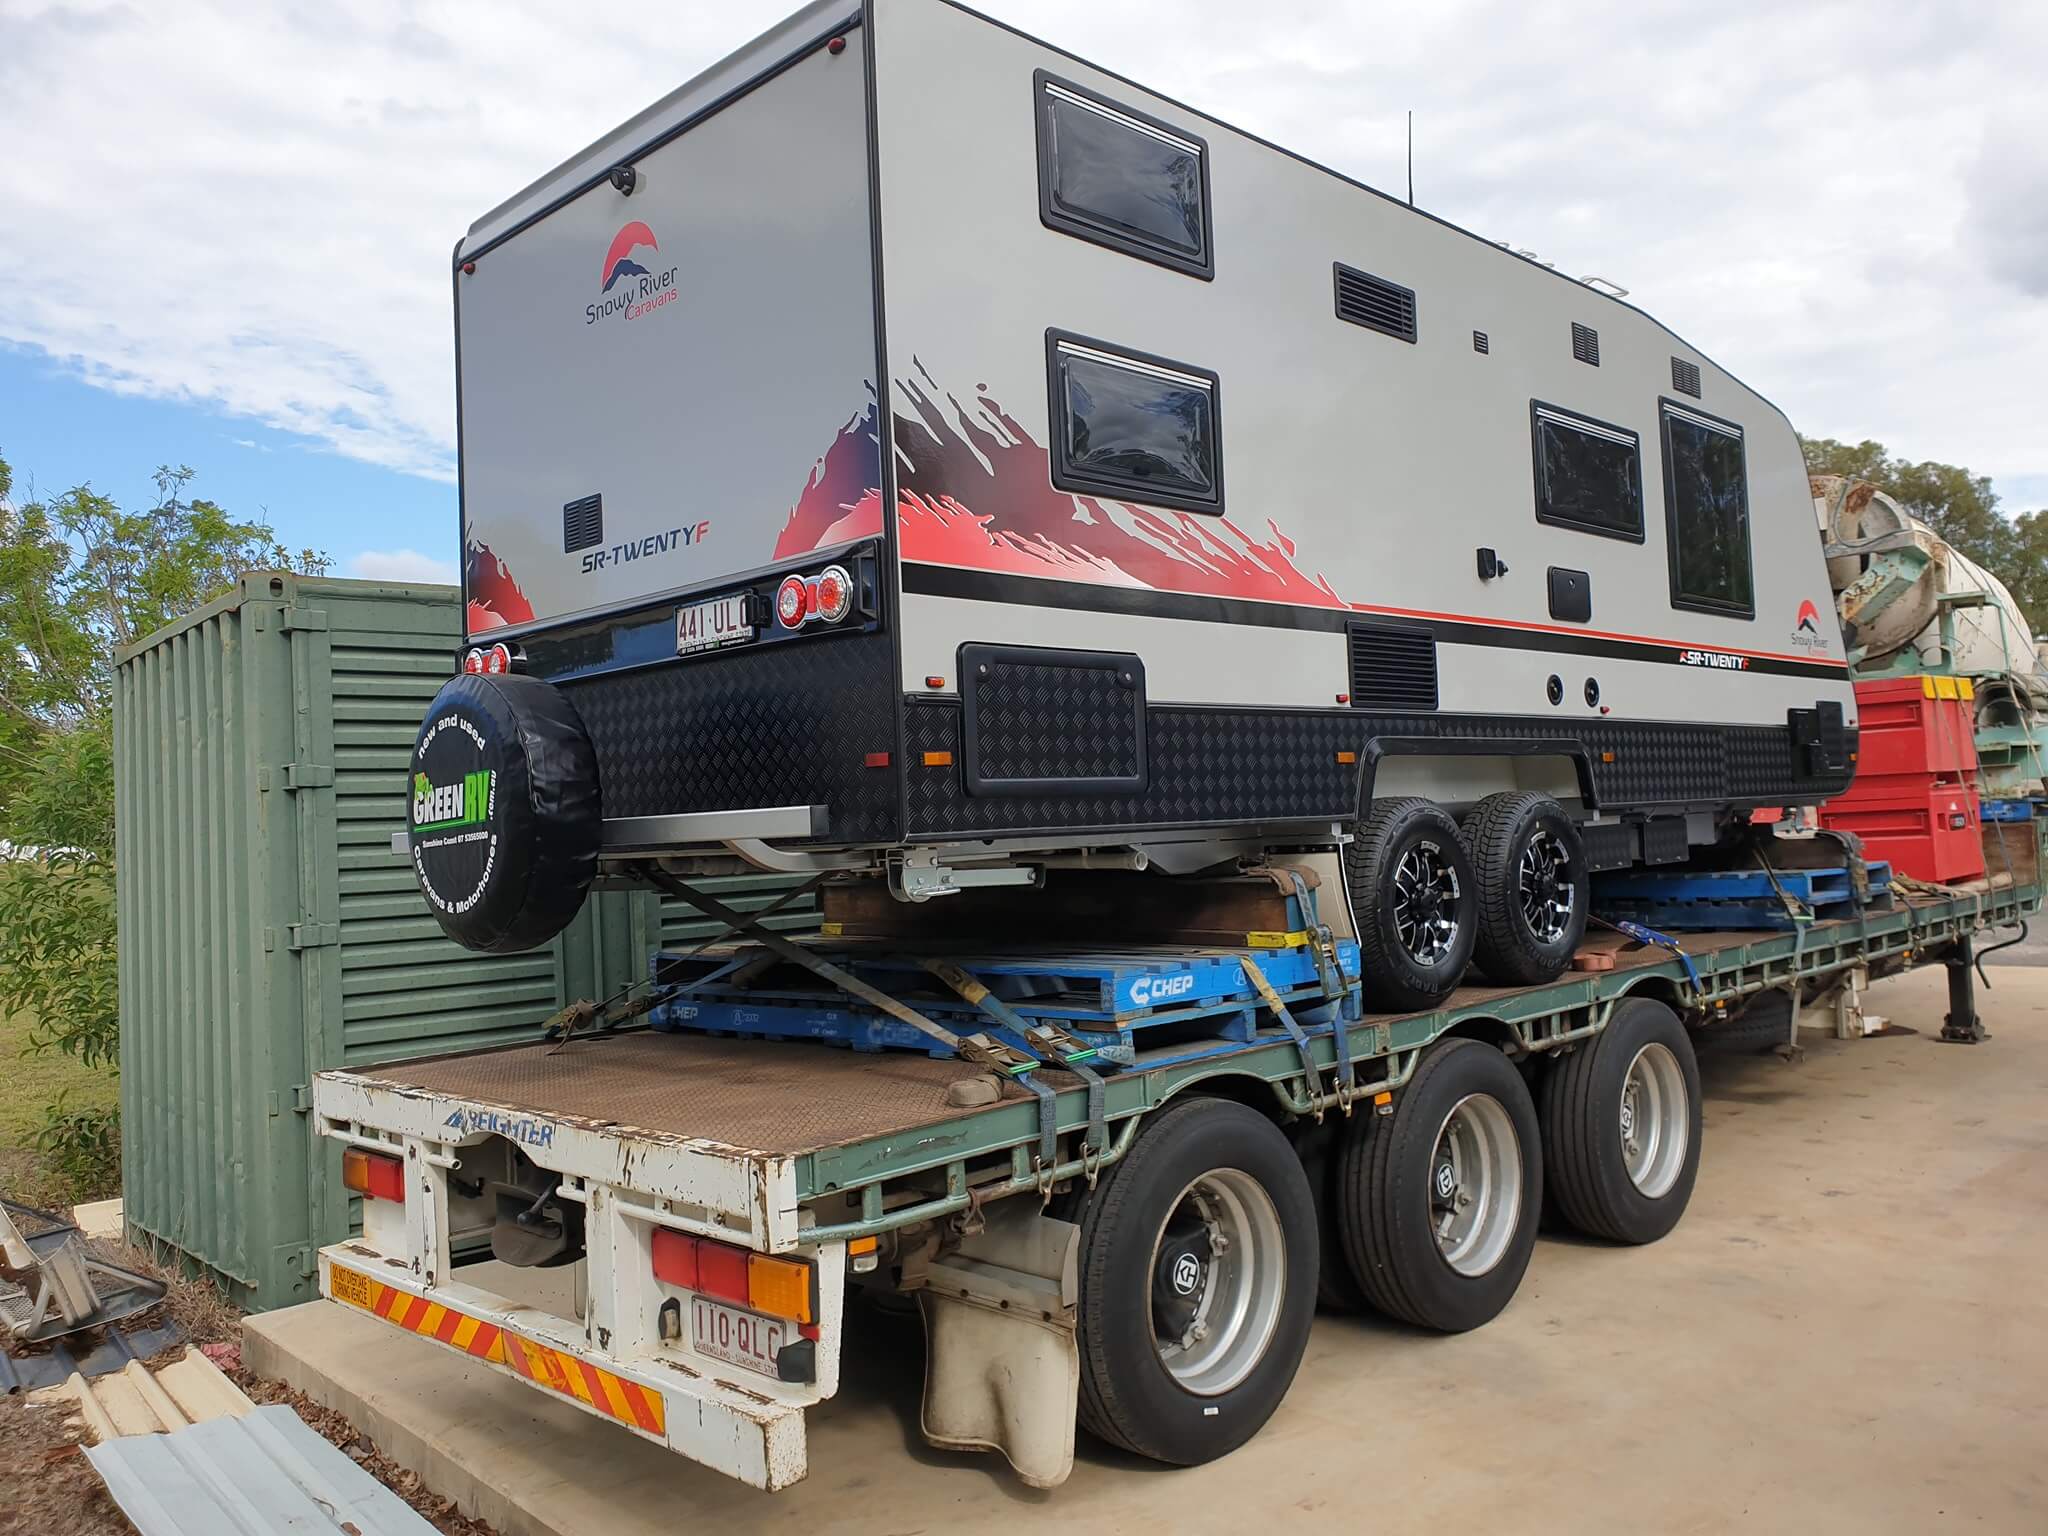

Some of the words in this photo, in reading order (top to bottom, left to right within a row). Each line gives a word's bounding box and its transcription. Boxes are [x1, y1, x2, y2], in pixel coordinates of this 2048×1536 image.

[586, 289, 634, 325] Snowy
[640, 266, 678, 299] River
[626, 288, 678, 321] Caravans
[581, 520, 710, 574] SR-TWENTYF
[418, 725, 436, 760] new
[438, 713, 458, 731] and
[460, 718, 486, 751] used
[414, 845, 446, 910] Caravans
[447, 901, 455, 914] &
[456, 834, 497, 914] Motorhomes
[1151, 974, 1194, 998] CHEP
[670, 1005, 699, 1021] CHEP
